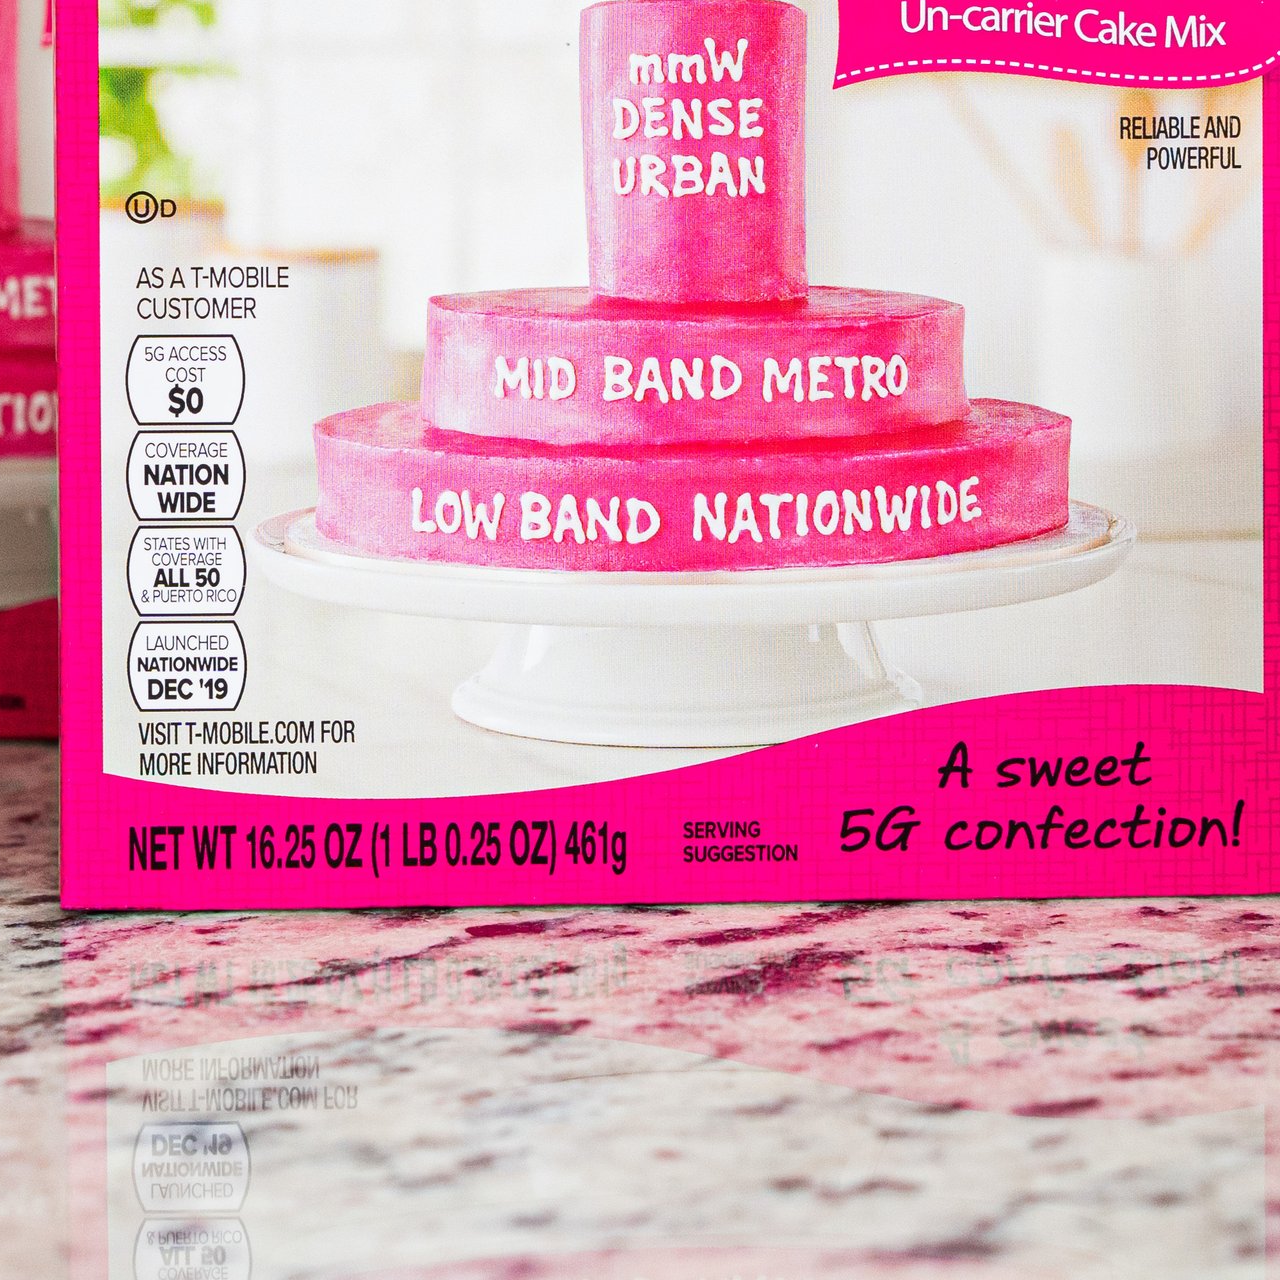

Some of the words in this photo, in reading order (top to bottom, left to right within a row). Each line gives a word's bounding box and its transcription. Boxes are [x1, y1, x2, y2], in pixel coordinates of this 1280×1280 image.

[900, 0, 1069, 38] Un-carrier
[1074, 11, 1158, 48] Cake
[1164, 14, 1227, 49] Mix
[629, 37, 748, 84] mmW
[613, 97, 764, 140] DENSE
[1120, 116, 1201, 140] RELIABLE
[1204, 115, 1242, 140] AND
[1146, 145, 1242, 170] POWERFUL
[613, 151, 766, 198] URBAN
[136, 267, 164, 289] AS
[170, 267, 186, 289] A
[191, 266, 289, 289] T-MOBILE
[136, 297, 257, 320] CUSTOMER
[144, 346, 165, 362] 5G
[168, 346, 227, 362] ACCESS
[165, 367, 206, 383] COST
[494, 355, 576, 400] MID
[603, 355, 742, 403] BAND
[763, 354, 909, 403] METRO
[168, 383, 204, 418] $0
[145, 442, 228, 458] COVERAGE
[143, 464, 229, 486] NATION
[157, 491, 216, 513] WIDE
[411, 487, 504, 540] LOW
[520, 491, 660, 544] BAND
[694, 476, 983, 544] NATIONWIDE
[143, 537, 190, 551] STATES
[193, 537, 227, 551] WITH
[151, 553, 222, 567] COVERAGE
[153, 568, 190, 588] ALL
[195, 567, 220, 588] 50
[141, 589, 151, 603] &
[152, 589, 204, 603] PUERTO
[206, 589, 238, 603] RICO
[146, 635, 229, 651] LAUNCHED
[137, 656, 238, 672] NATIONWIDE
[148, 678, 193, 700] DEC
[199, 678, 228, 700] '19
[138, 722, 182, 745] VISIT
[185, 720, 314, 745] T-MOBILE.COM
[320, 719, 355, 744] FOR
[139, 752, 191, 776] MORE
[197, 751, 317, 775] INFORMATION
[937, 740, 973, 789] A
[996, 740, 1152, 789] sweet
[683, 821, 761, 840] SERVING
[839, 805, 921, 853] 5G
[944, 799, 1245, 852] confection!
[128, 826, 185, 871] NET
[192, 824, 234, 870] WT
[246, 823, 316, 869] 16.25
[324, 822, 363, 868] OZ
[370, 821, 392, 878] (1
[402, 822, 436, 867] LB
[445, 821, 502, 866] 0.25
[511, 820, 557, 876] OZ)
[564, 820, 628, 875] 461g
[683, 844, 799, 863] SUGGESTION
